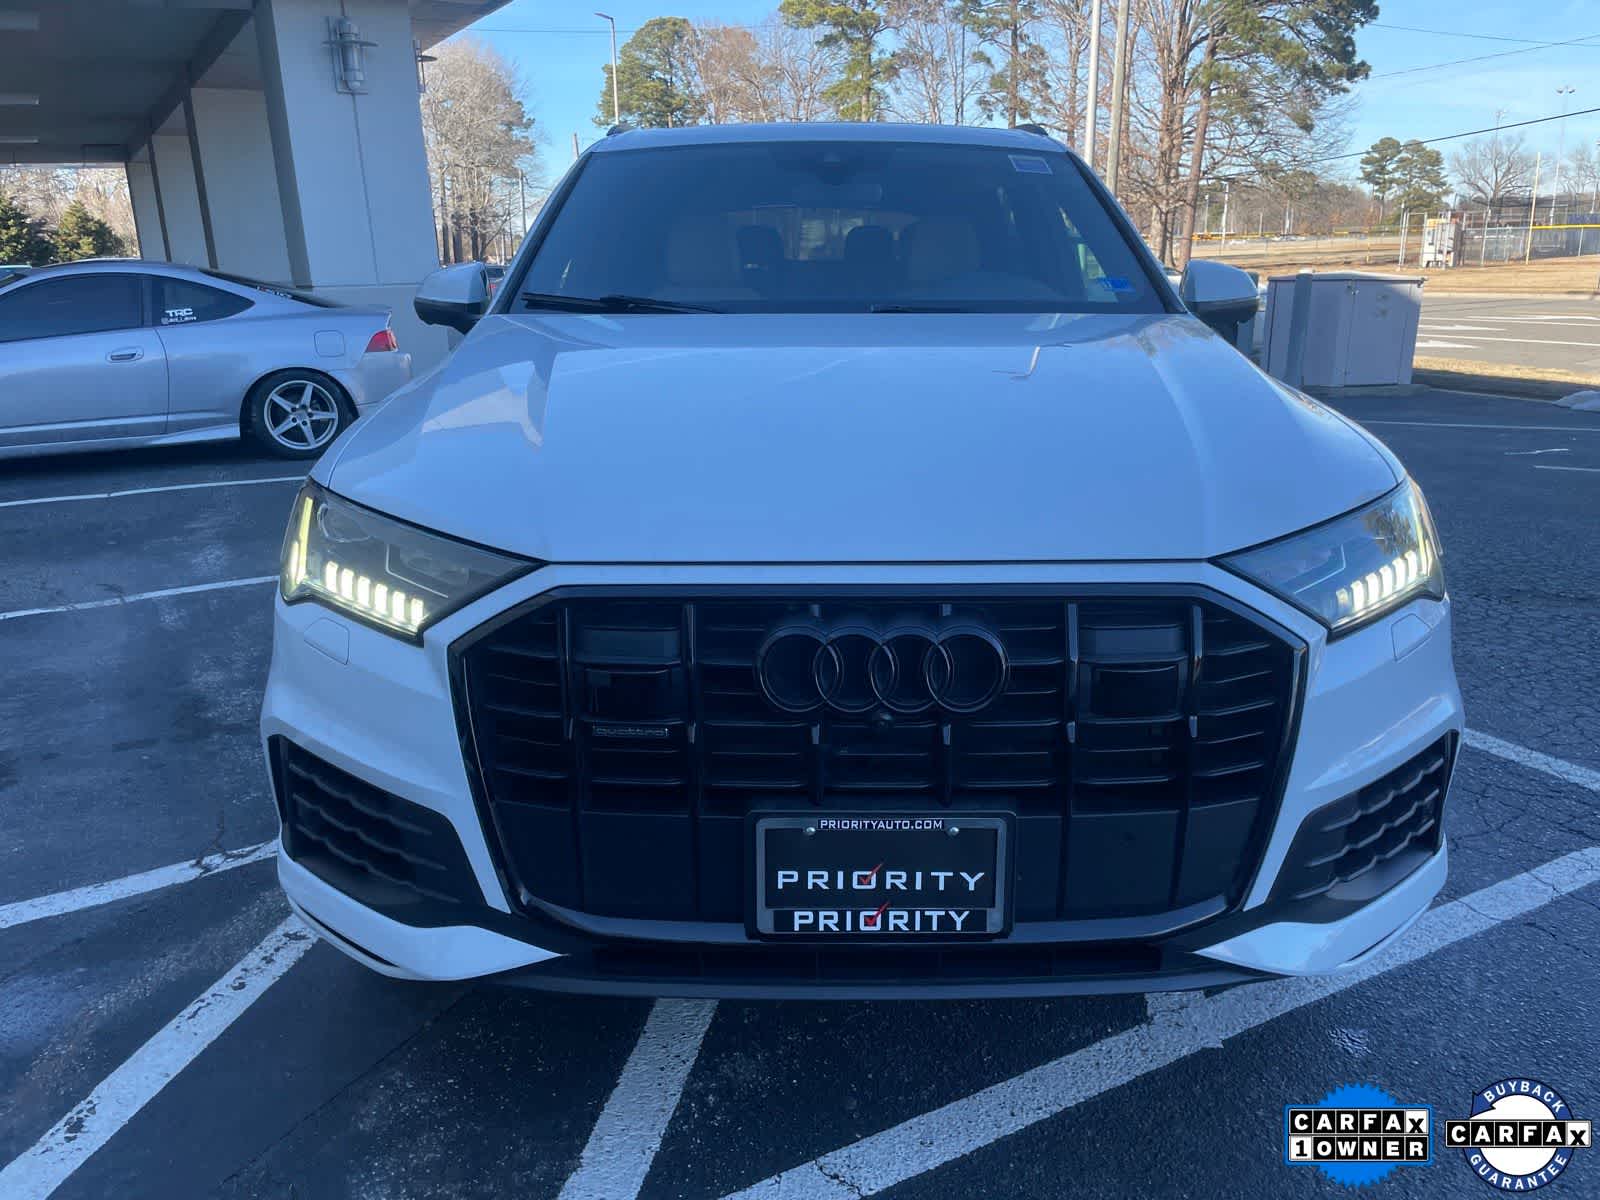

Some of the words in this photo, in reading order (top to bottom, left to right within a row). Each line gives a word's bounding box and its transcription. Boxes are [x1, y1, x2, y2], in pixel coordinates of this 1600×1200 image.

[820, 819, 943, 830] PRIORITYAUTO.COM
[777, 870, 985, 891] PRIORITY
[793, 910, 970, 931] PRIORITY
